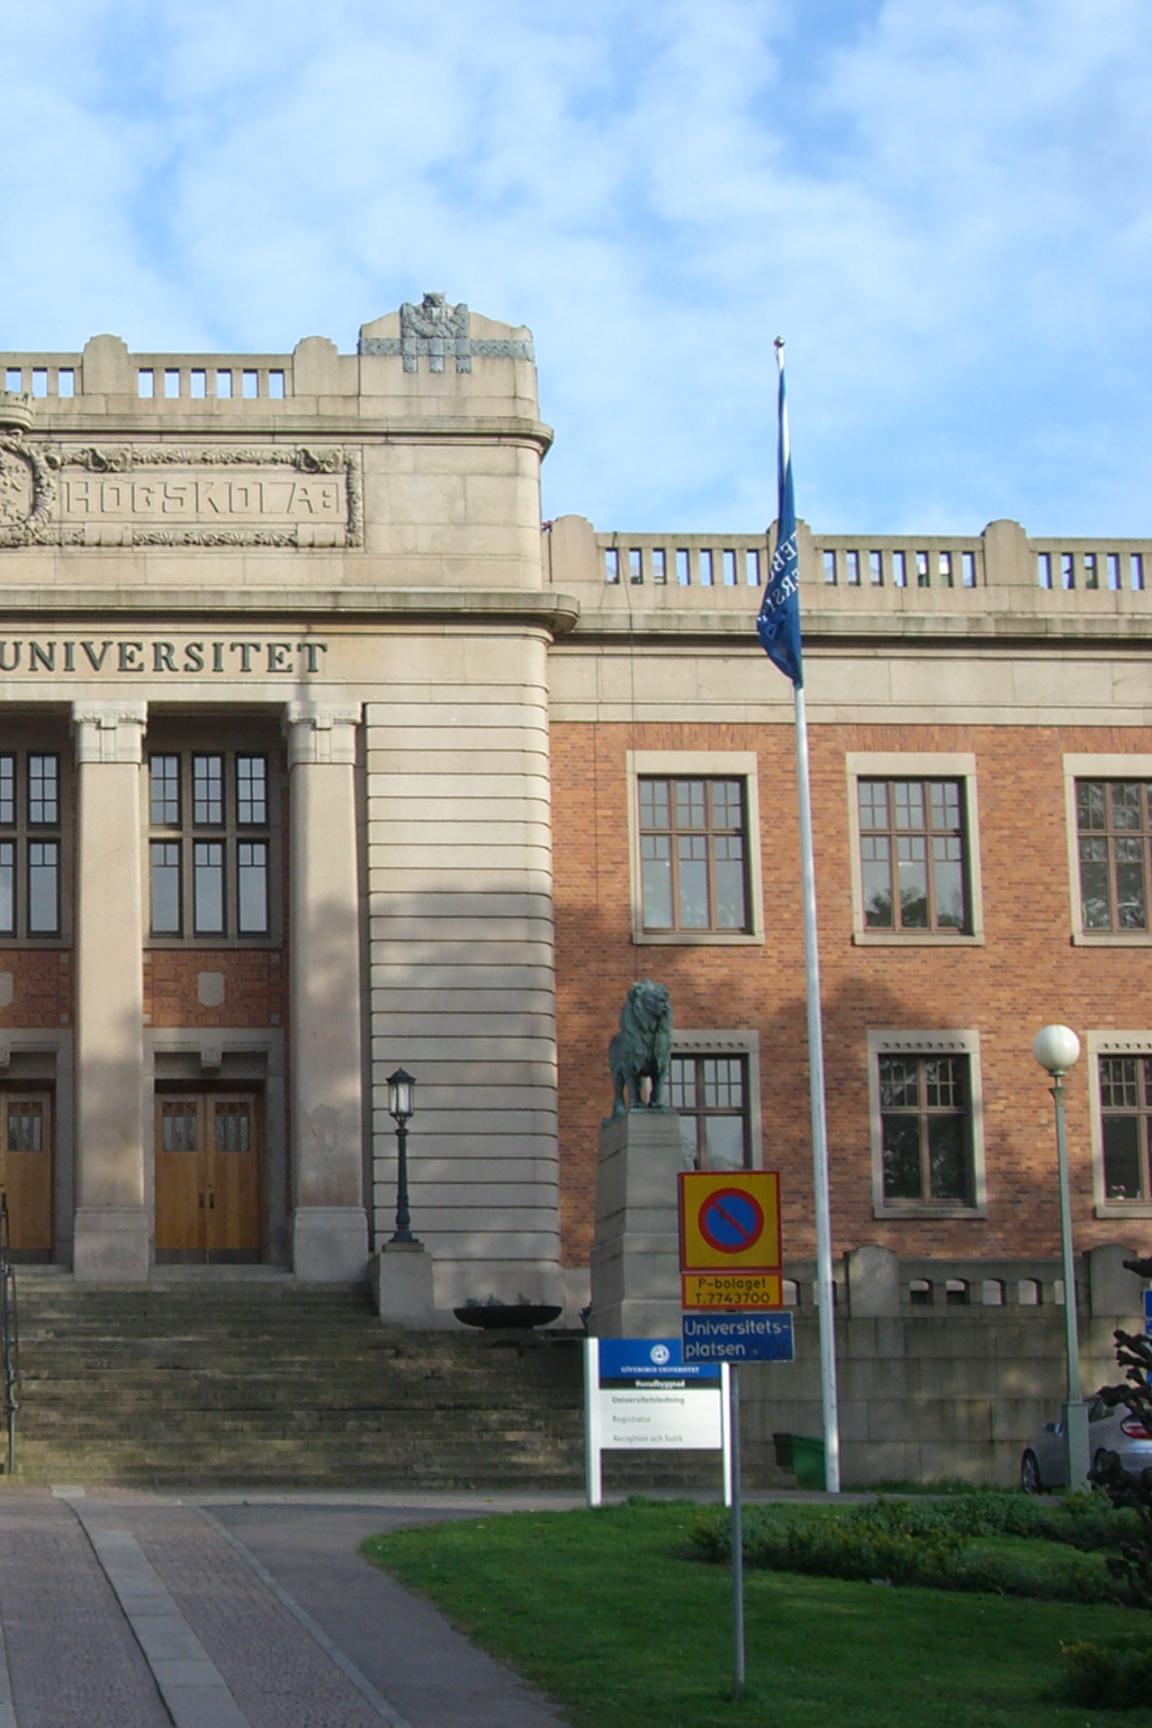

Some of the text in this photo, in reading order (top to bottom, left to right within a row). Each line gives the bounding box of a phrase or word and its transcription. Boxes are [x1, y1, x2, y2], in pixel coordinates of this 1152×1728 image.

[698, 1278, 766, 1291] P-bolaget
[685, 1320, 788, 1336] Universitets-
[686, 1341, 746, 1360] platsen
